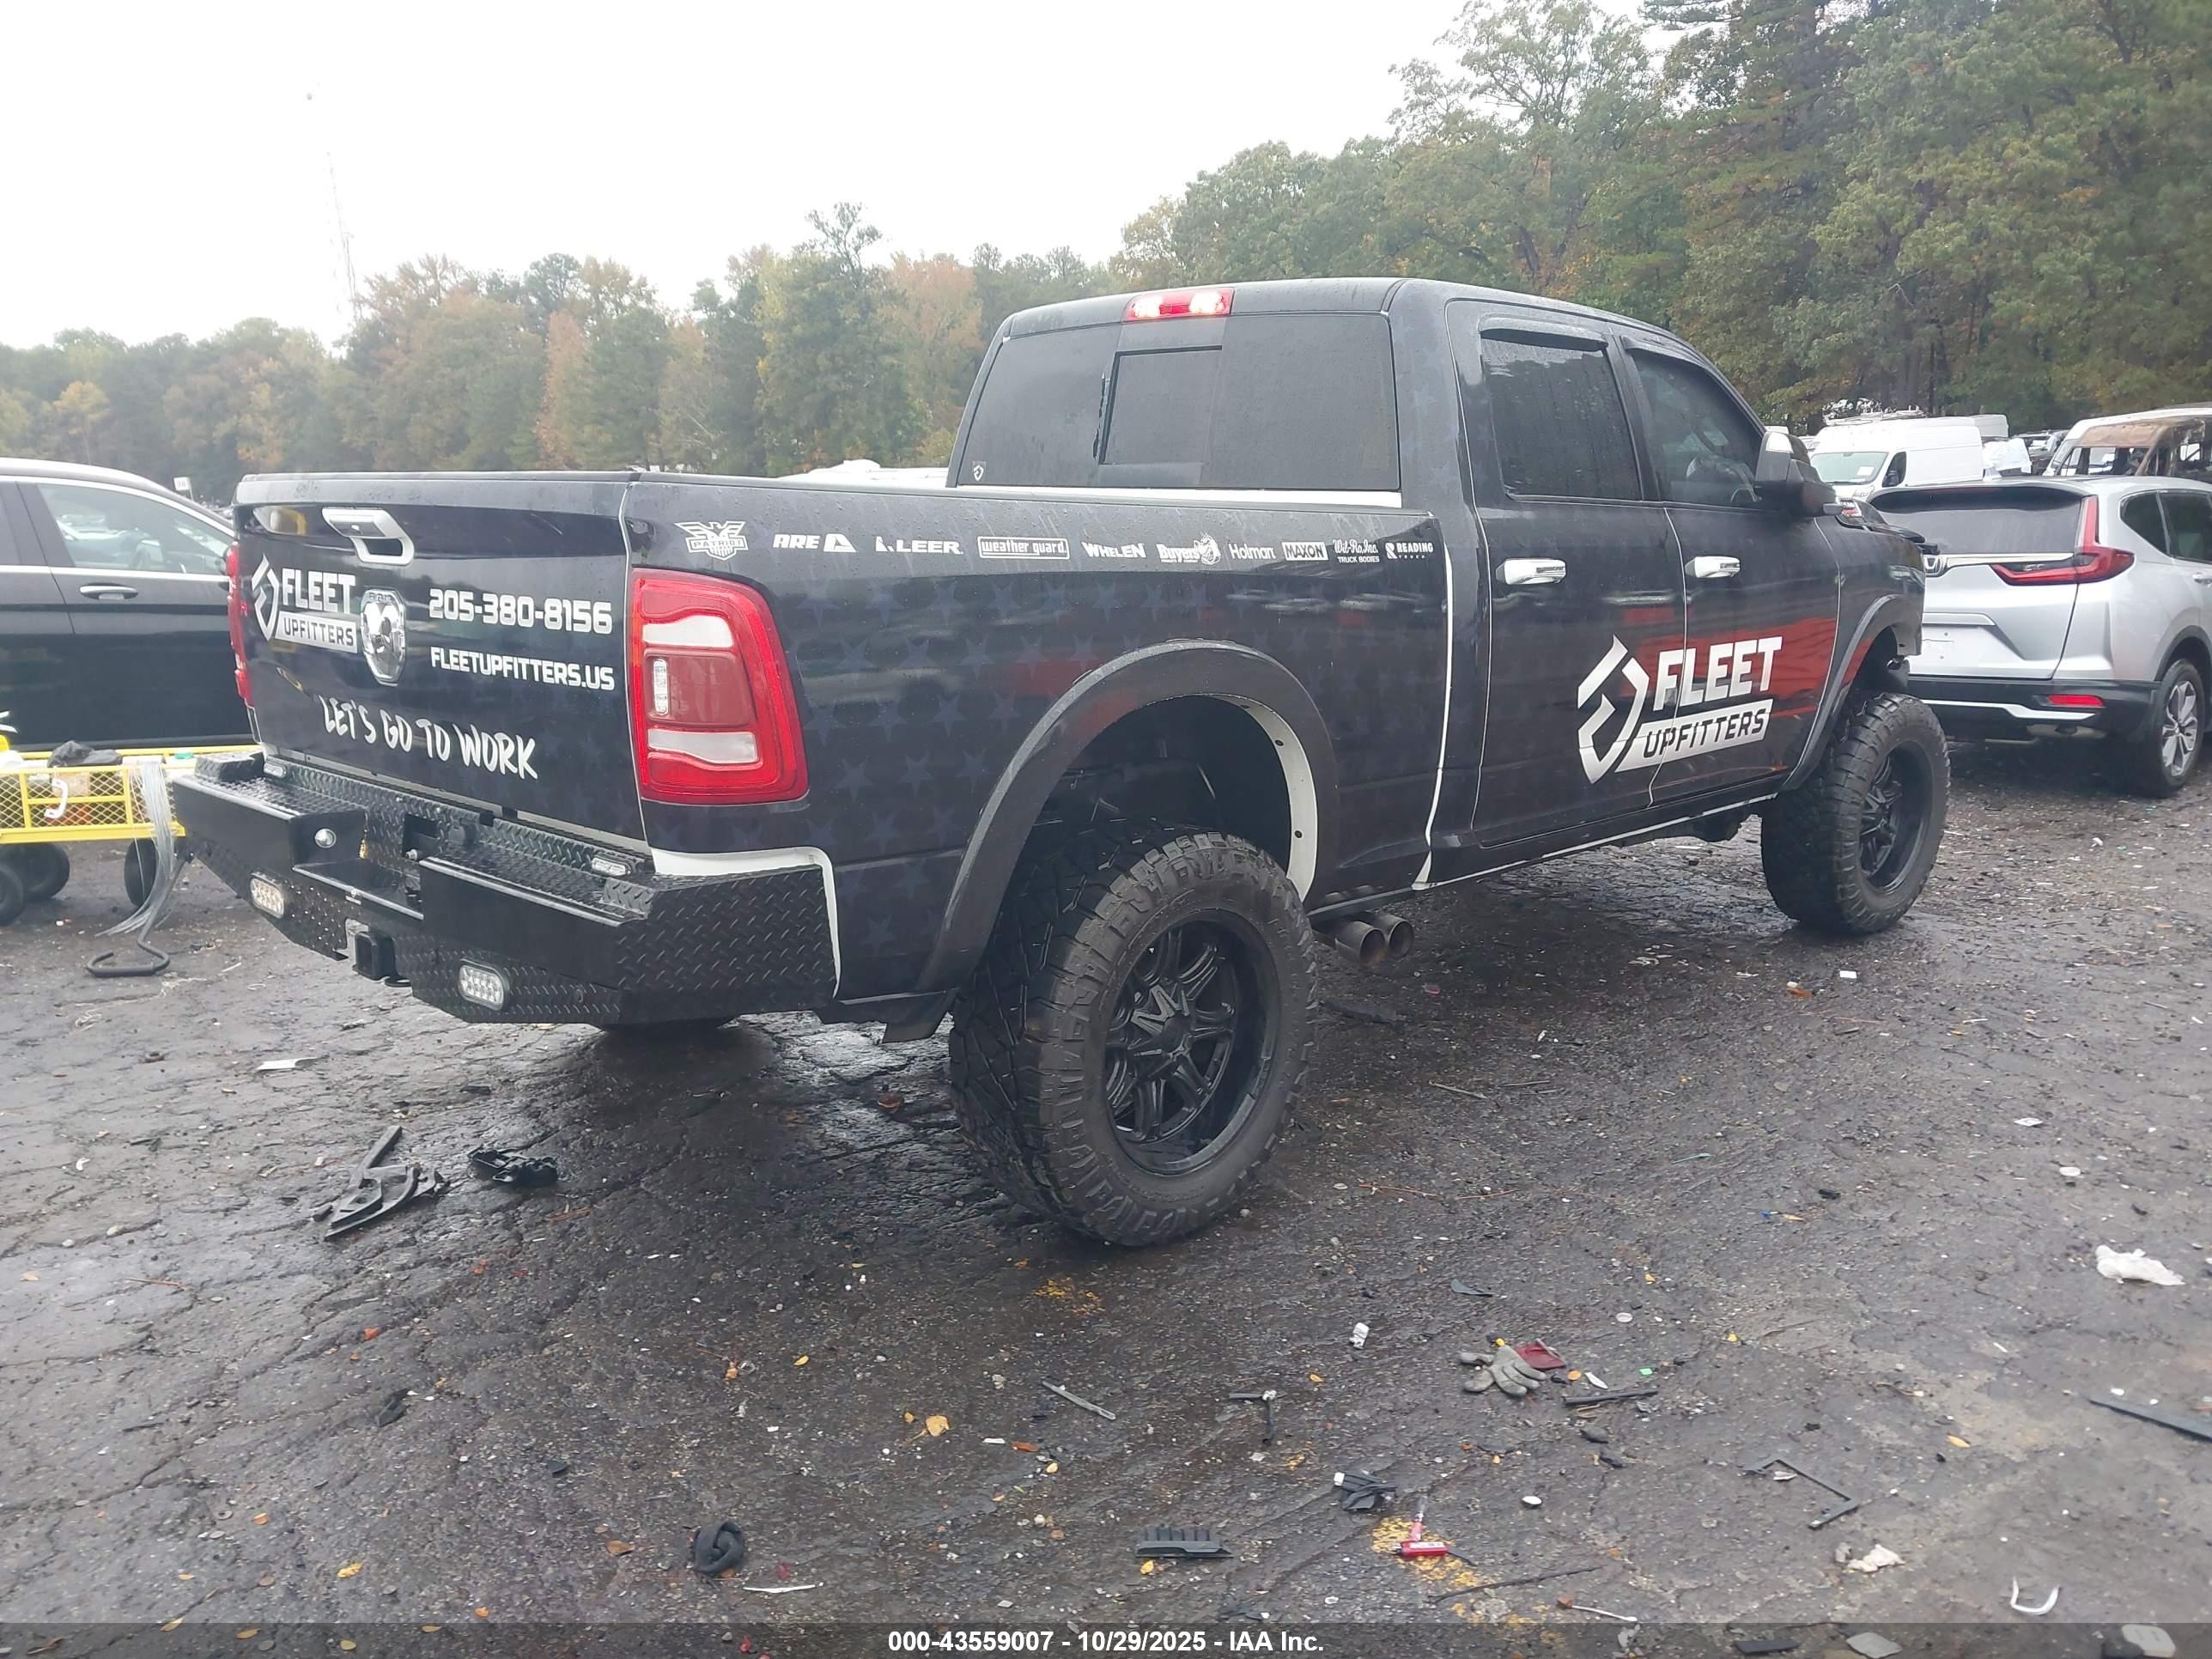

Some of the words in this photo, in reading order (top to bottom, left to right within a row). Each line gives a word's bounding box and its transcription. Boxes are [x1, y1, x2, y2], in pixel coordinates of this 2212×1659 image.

[692, 539, 742, 548] PATRIOT
[773, 534, 821, 550] ARE
[896, 539, 963, 555] LEER
[981, 539, 1030, 554] weather
[1082, 541, 1147, 558] WHELEN
[1396, 542, 1433, 553] READING
[1157, 544, 1200, 563] Buyers
[1229, 543, 1276, 559] Holman
[1284, 544, 1324, 558] MAXON
[1358, 555, 1380, 563] BODIES
[282, 568, 356, 615] FLEET
[428, 587, 613, 635] 205-380-8156
[283, 617, 354, 647] UPFITTERS
[430, 646, 616, 691] FLEETUPFITTERS.US
[1652, 636, 1784, 711] FLEET
[319, 695, 377, 744] LET'S
[380, 708, 413, 753] GO
[415, 718, 451, 763] TO
[452, 724, 538, 781] WORK
[1643, 708, 1767, 759] UPFITTERS
